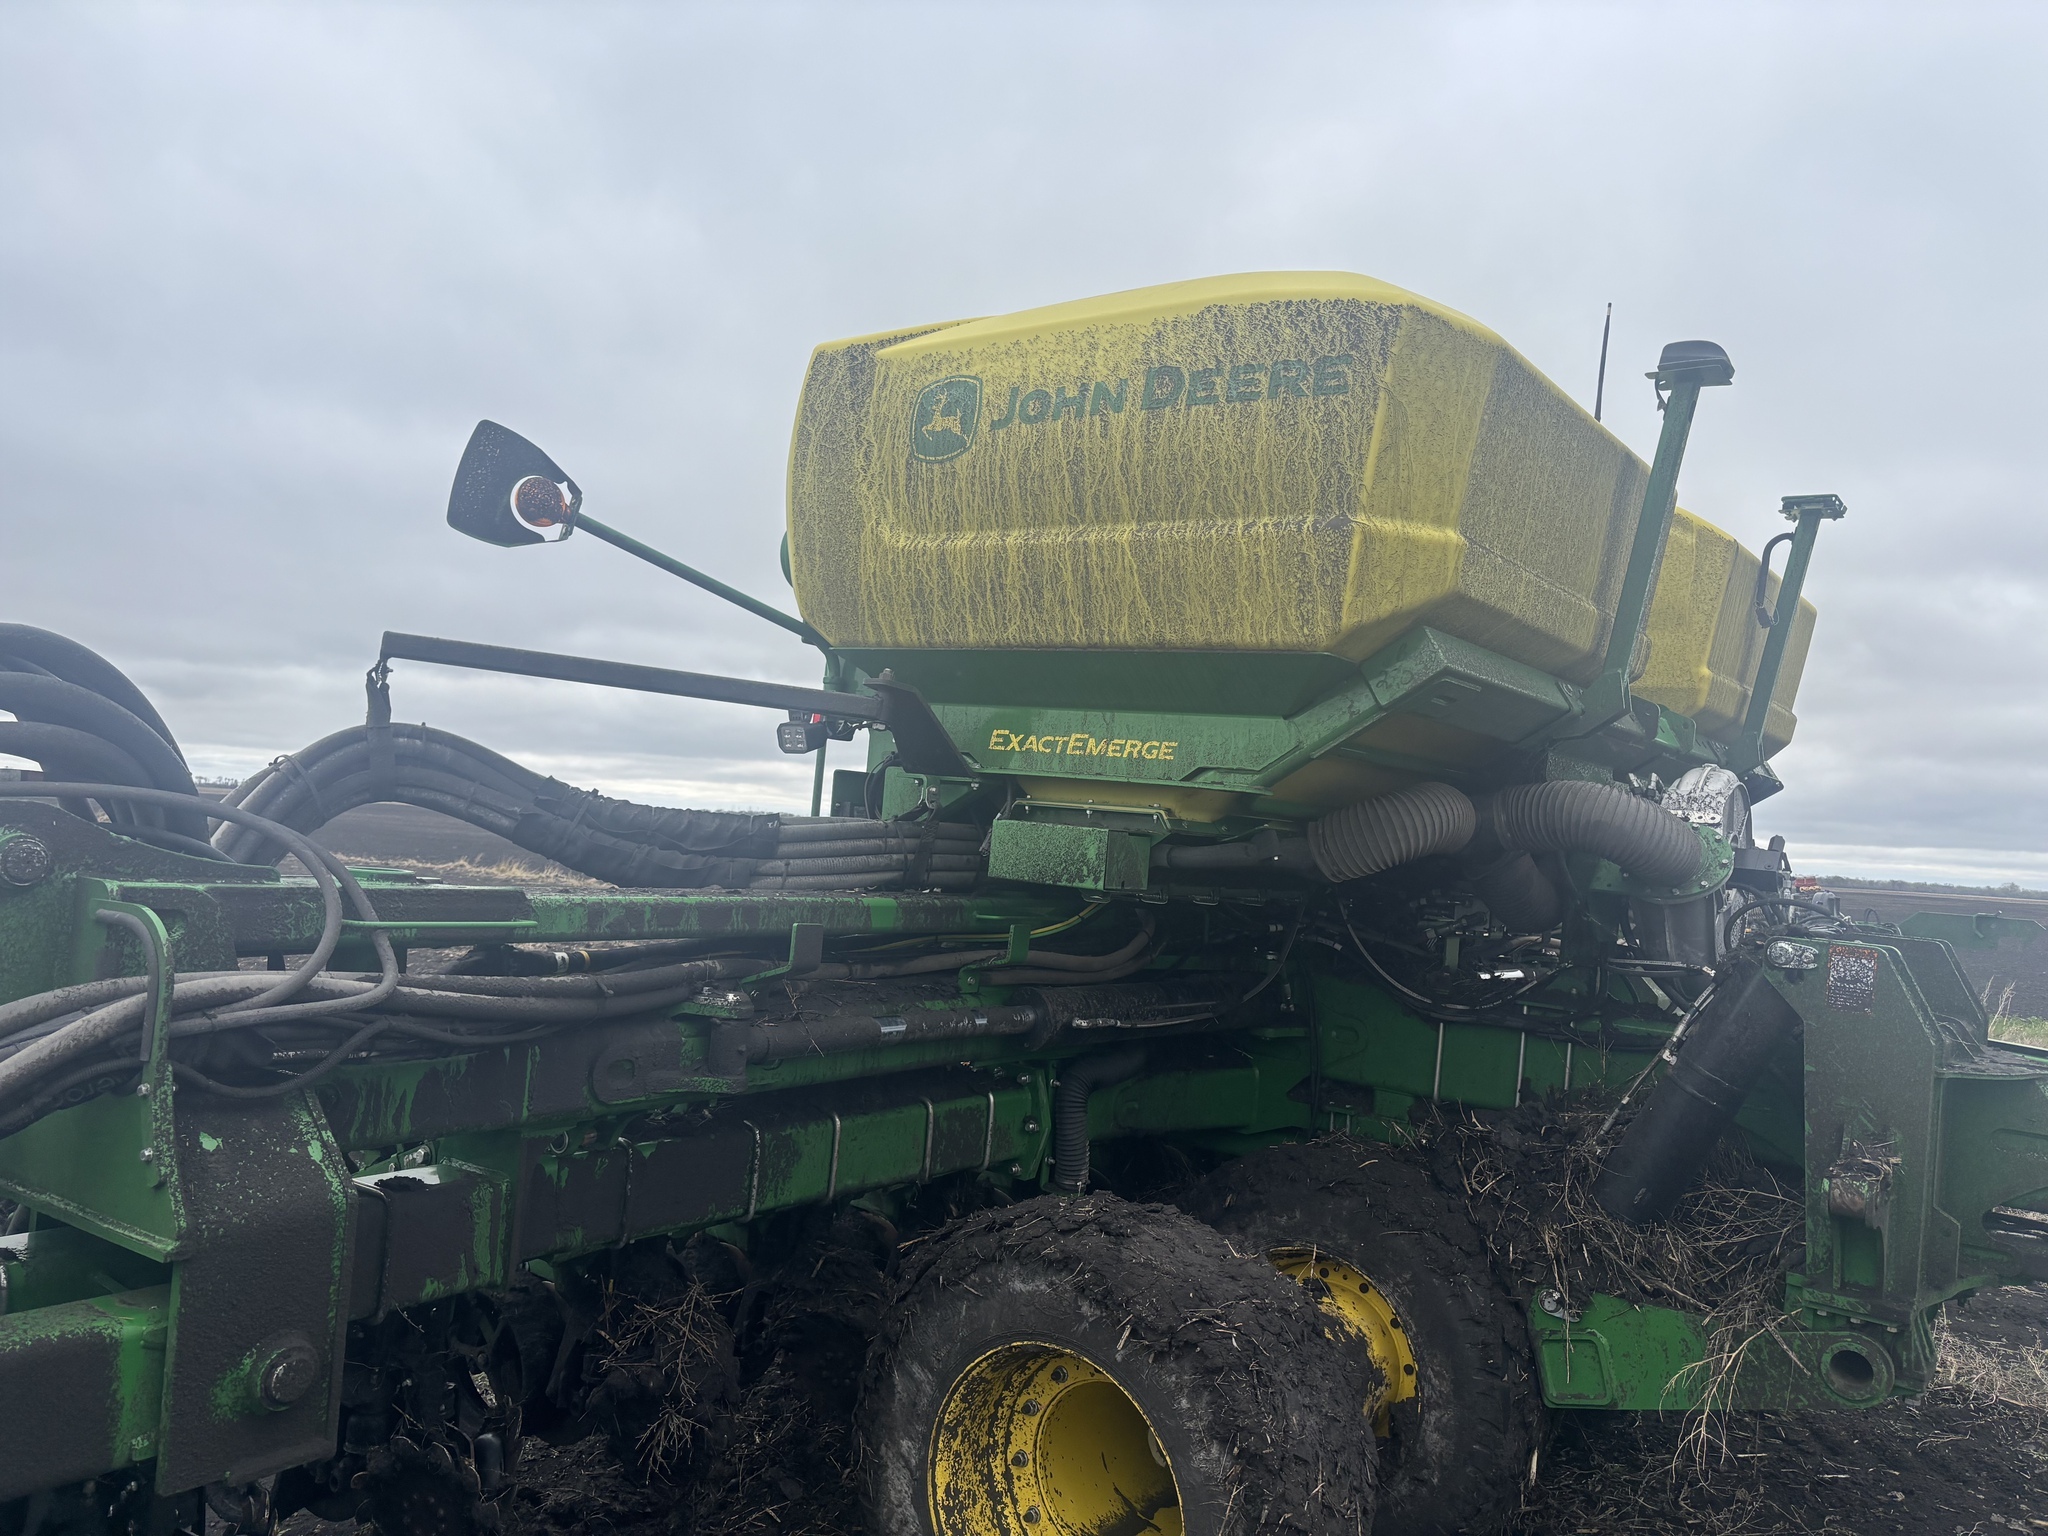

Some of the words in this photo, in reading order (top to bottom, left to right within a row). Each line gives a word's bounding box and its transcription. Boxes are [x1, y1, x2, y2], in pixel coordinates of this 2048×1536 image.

[990, 378, 1130, 431] JOHN
[1140, 354, 1353, 411] DEERE
[988, 729, 1178, 760] EXACTEMERGE
